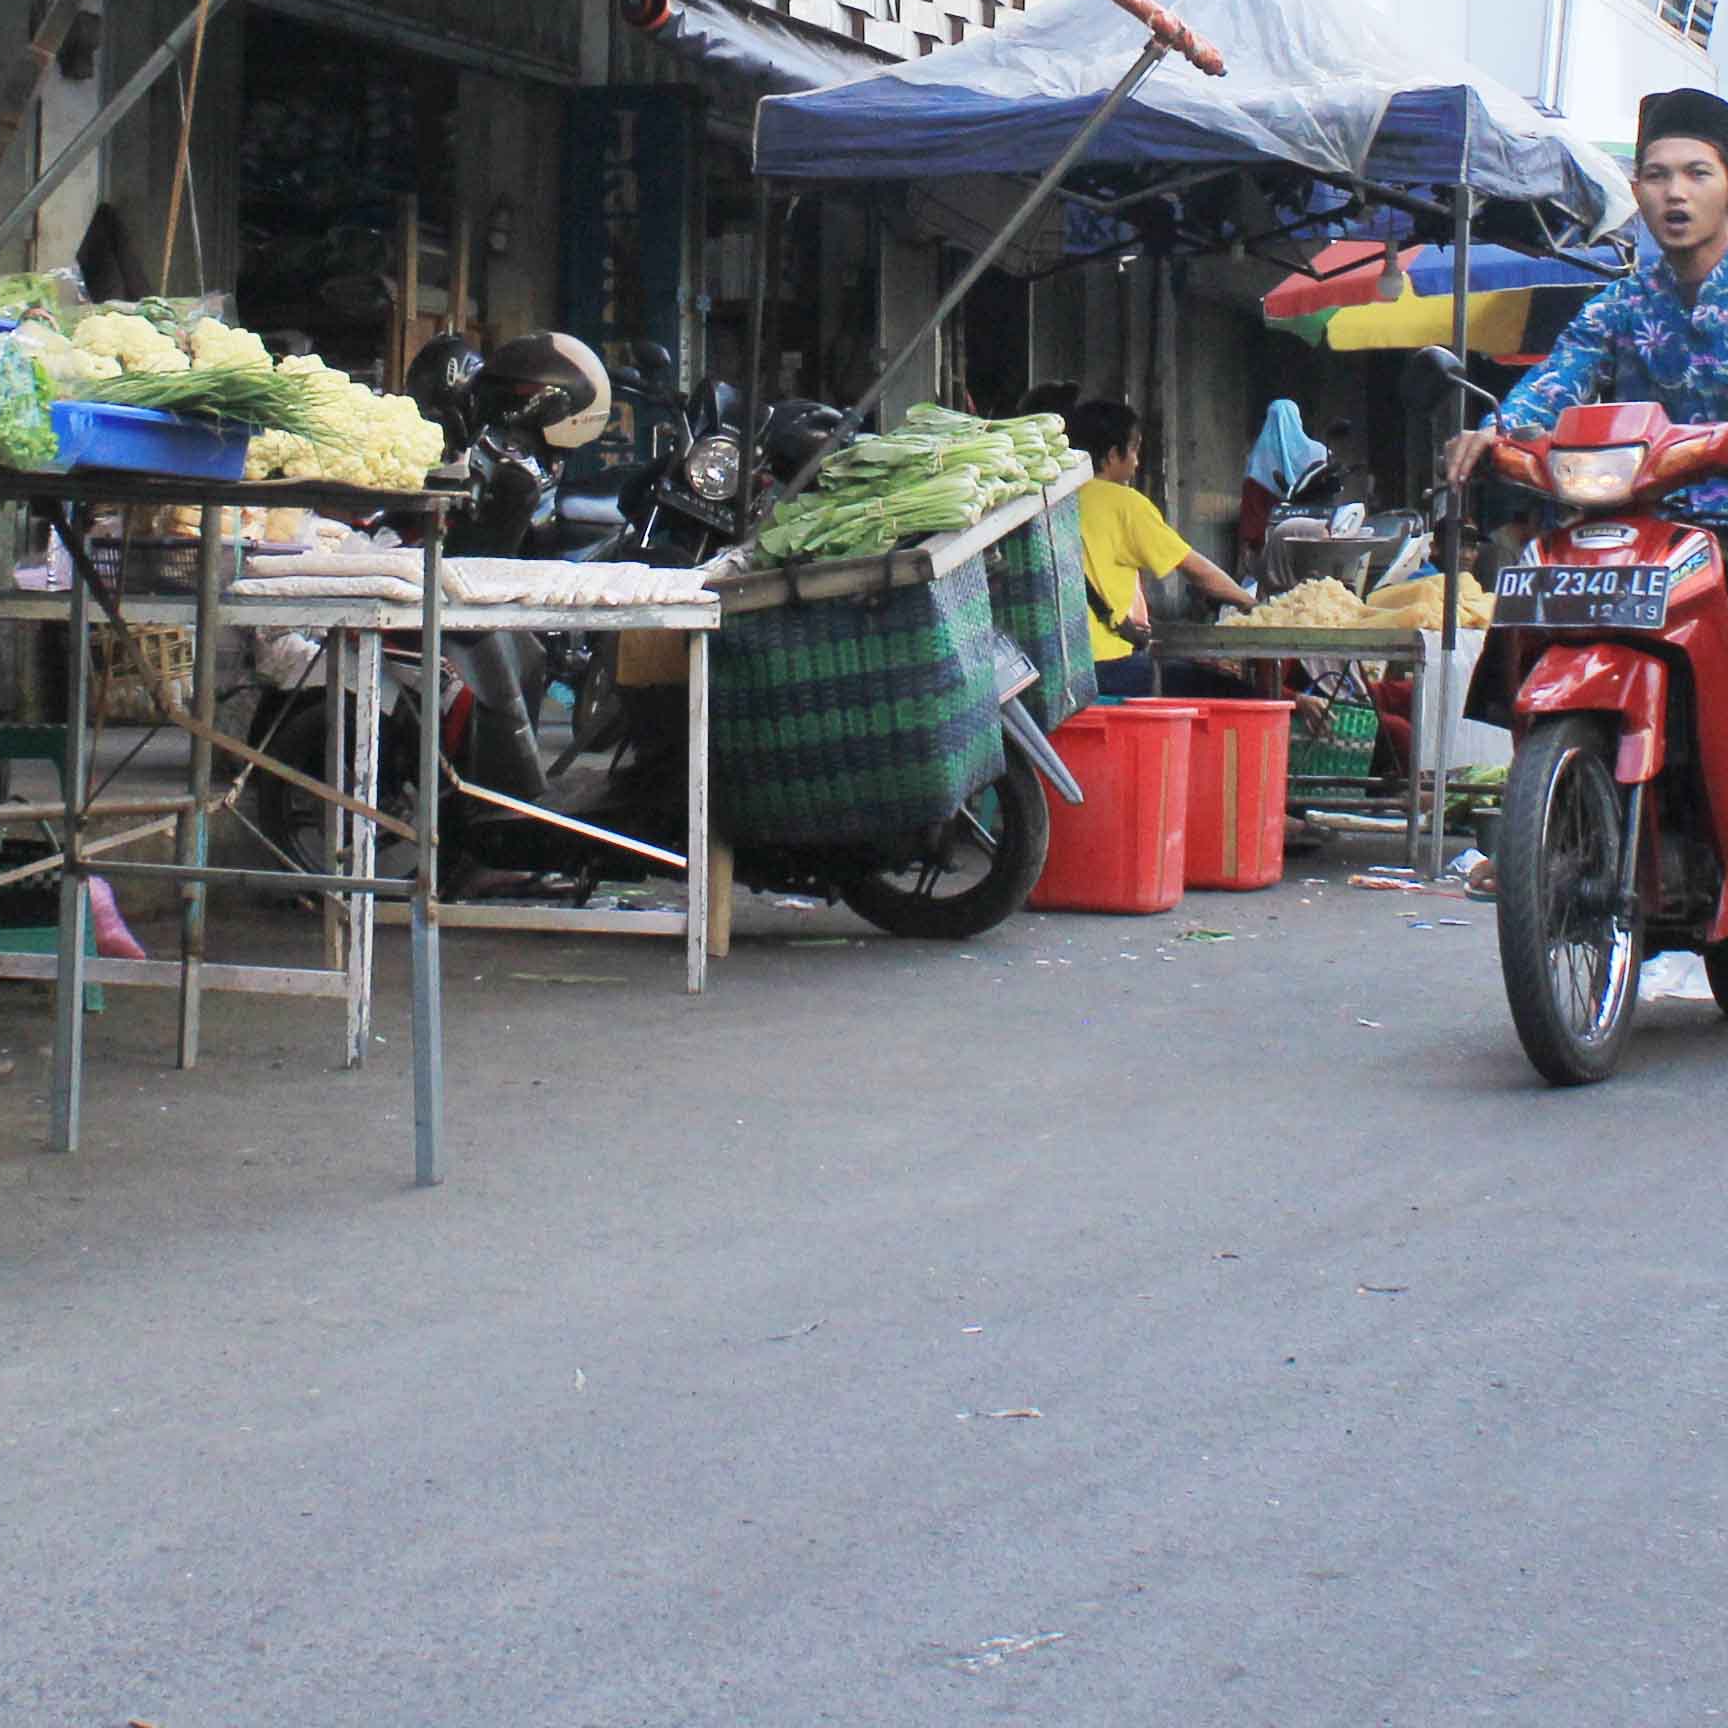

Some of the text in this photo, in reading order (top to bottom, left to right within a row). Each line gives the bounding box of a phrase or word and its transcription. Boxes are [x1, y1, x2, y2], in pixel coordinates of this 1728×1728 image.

[1501, 572, 1666, 597] DK 2340 LE
